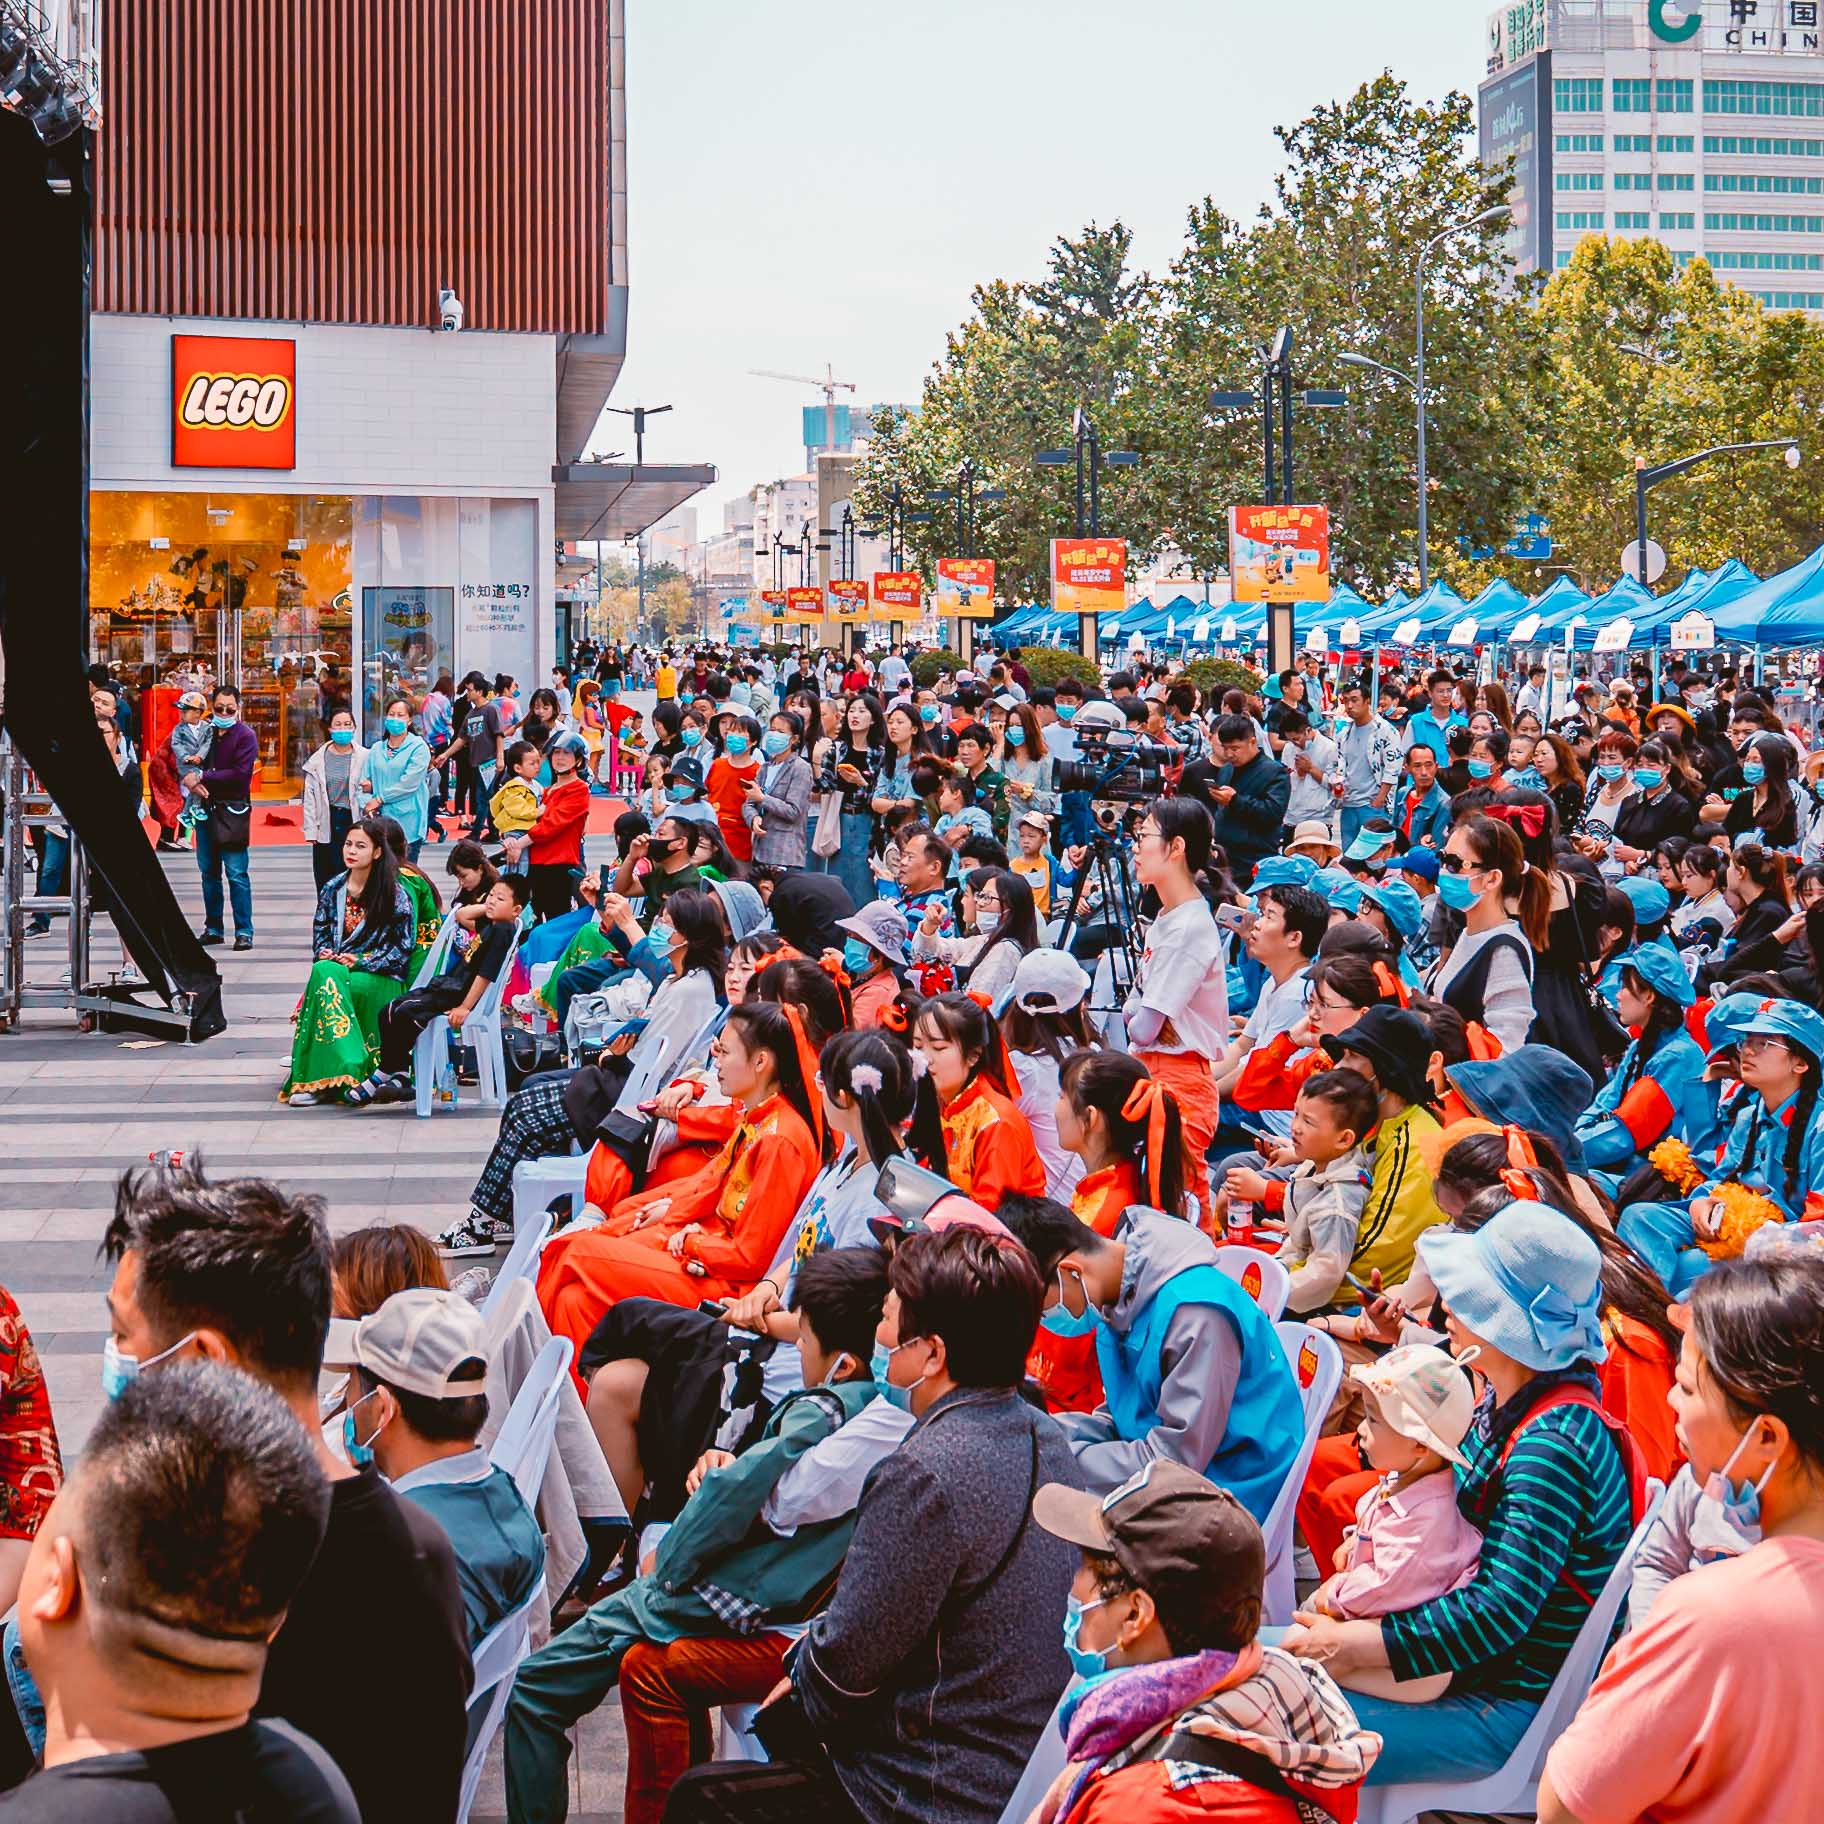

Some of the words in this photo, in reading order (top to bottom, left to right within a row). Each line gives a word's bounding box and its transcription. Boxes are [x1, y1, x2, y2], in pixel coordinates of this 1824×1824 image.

[182, 377, 289, 426] LEGO
[462, 583, 530, 599] 你知道吗?
